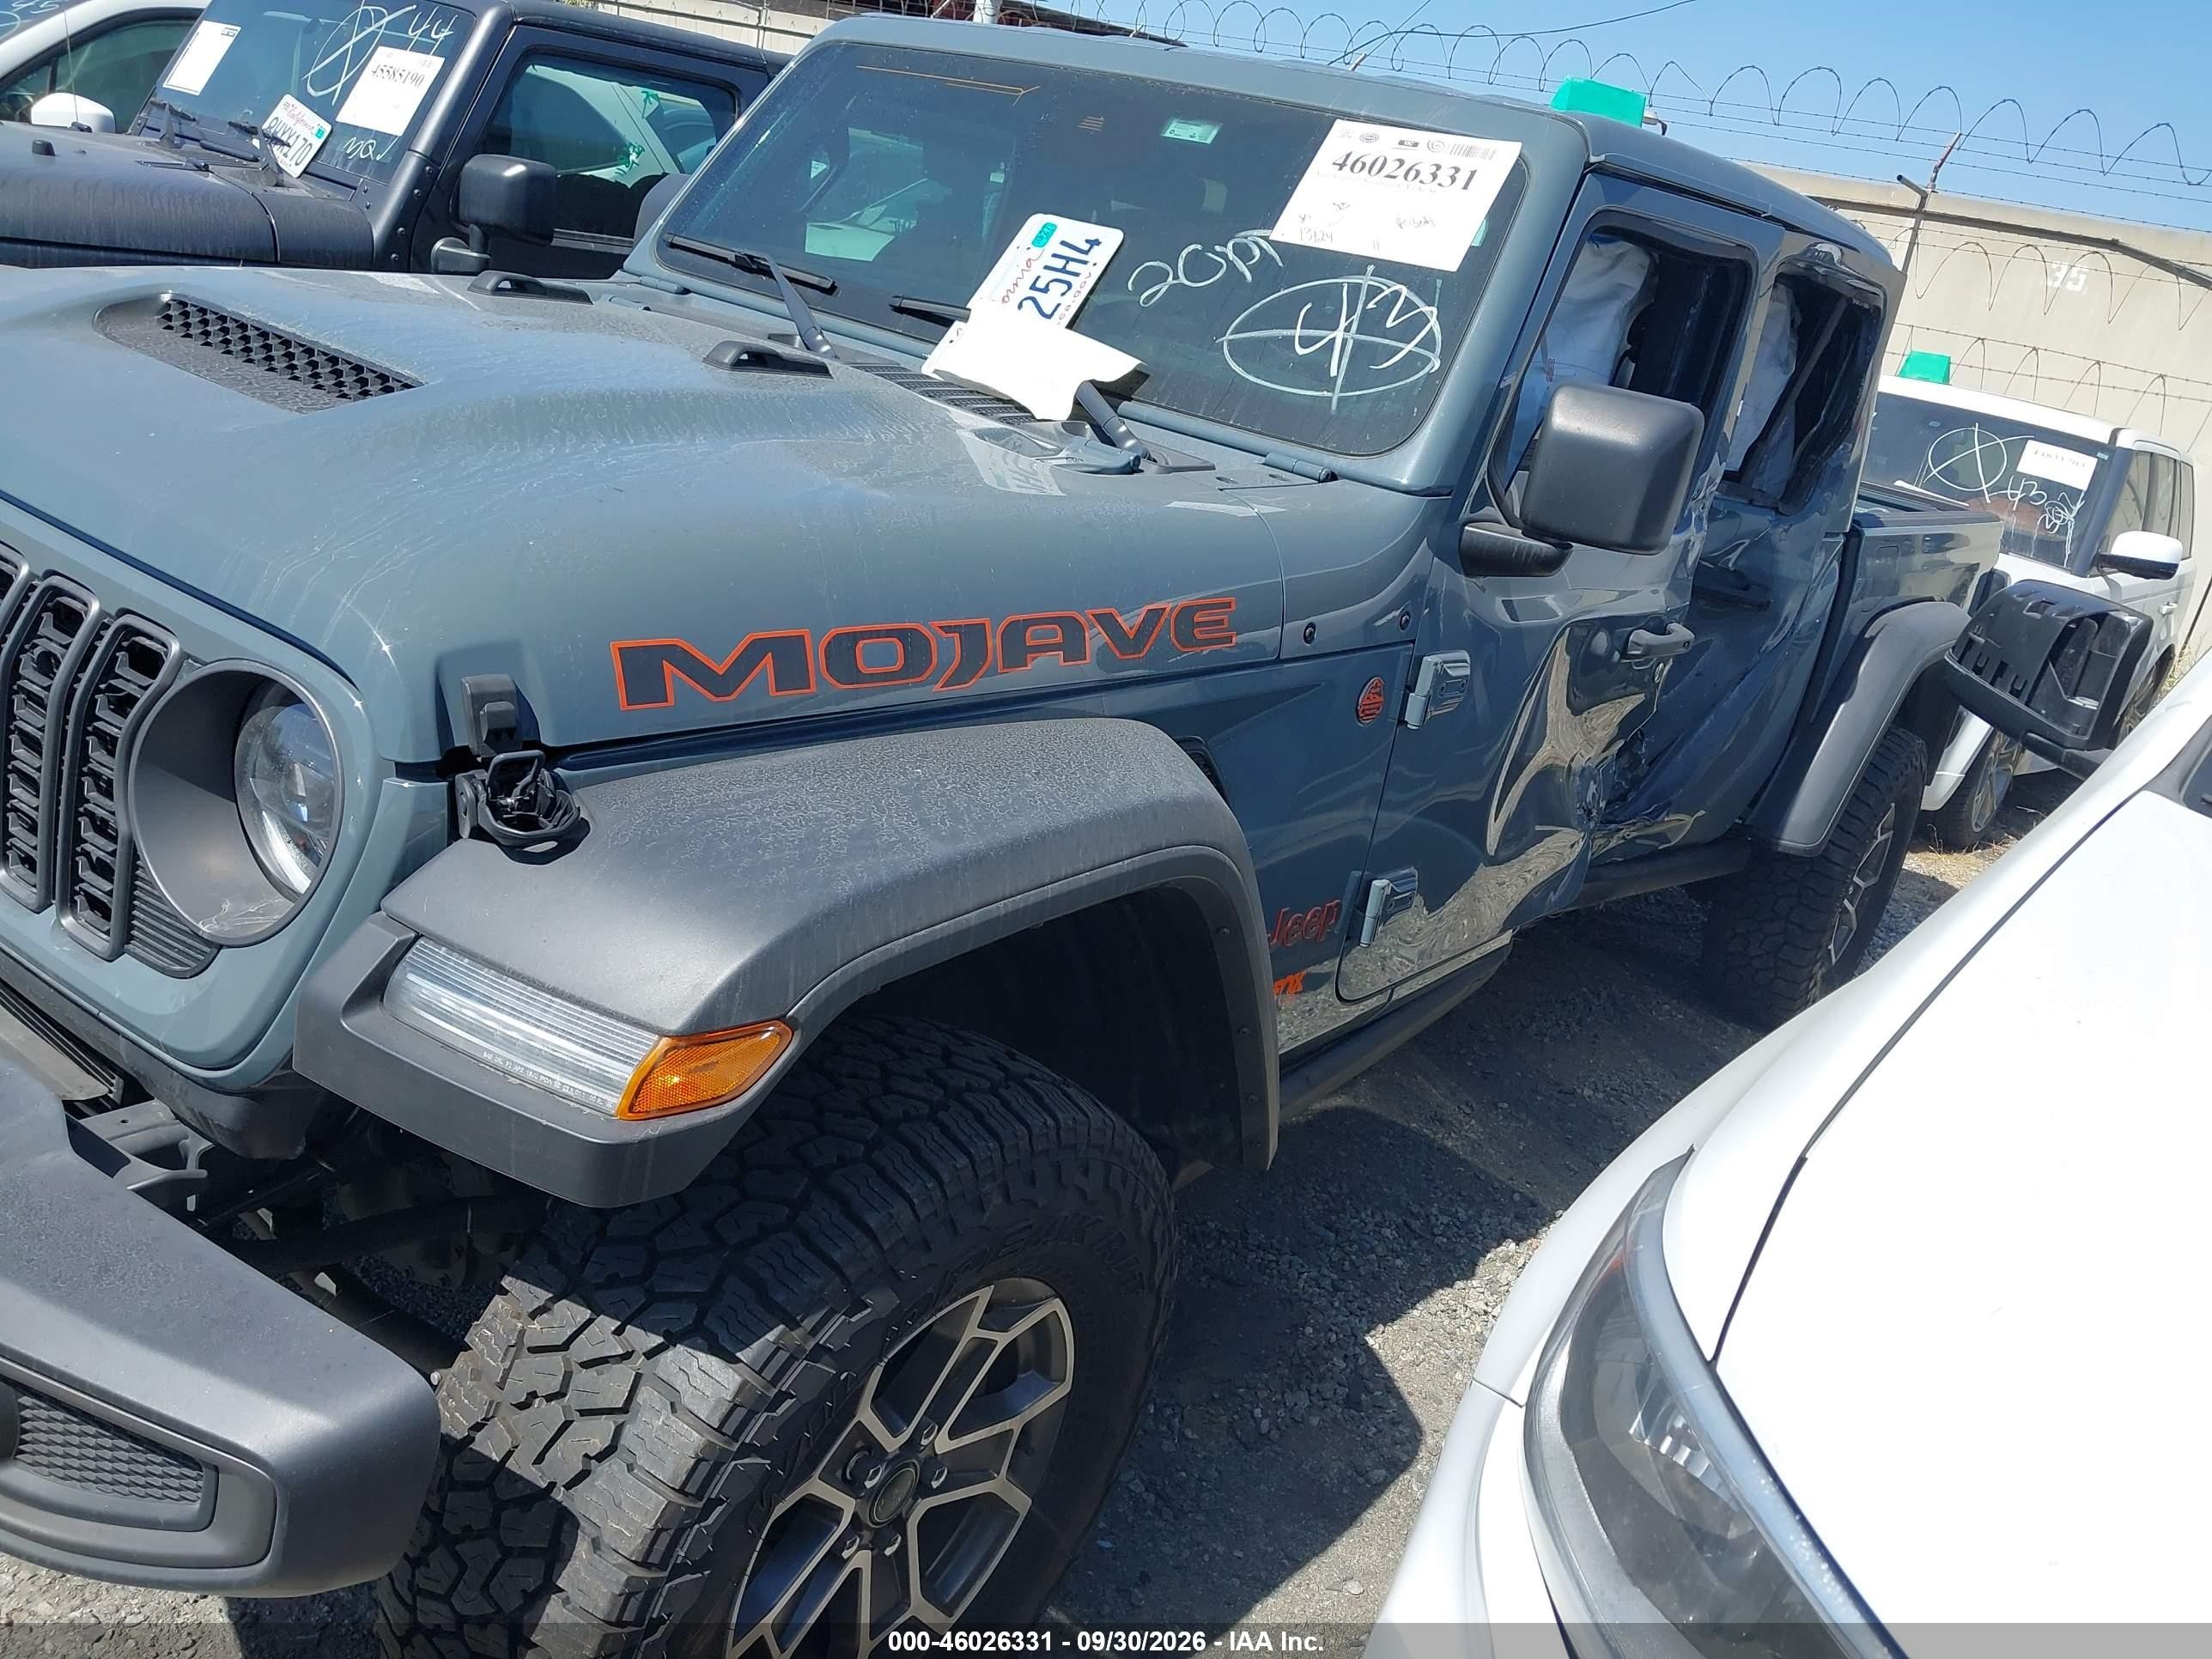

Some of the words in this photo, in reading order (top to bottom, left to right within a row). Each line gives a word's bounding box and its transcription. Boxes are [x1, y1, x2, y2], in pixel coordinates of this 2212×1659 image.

[1332, 150, 1478, 191] 46026331
[1018, 238, 1102, 319] 25H4
[610, 597, 1237, 711] MOJAVE
[1267, 899, 1341, 947] Jeep
